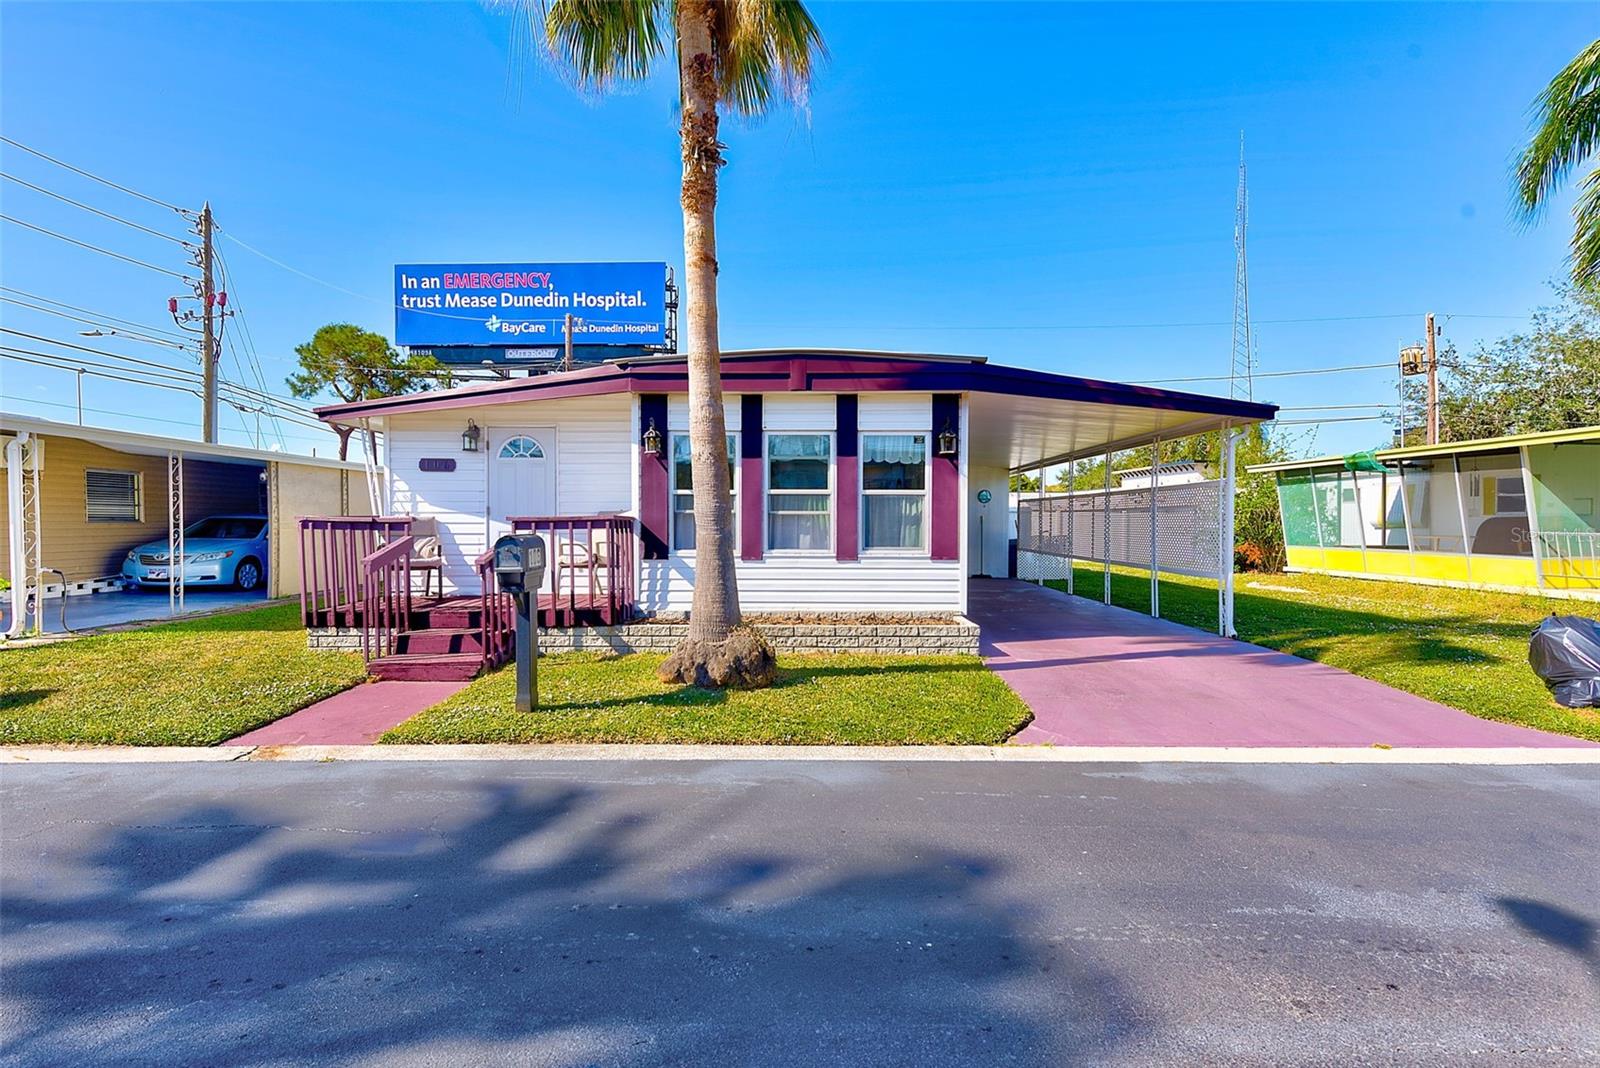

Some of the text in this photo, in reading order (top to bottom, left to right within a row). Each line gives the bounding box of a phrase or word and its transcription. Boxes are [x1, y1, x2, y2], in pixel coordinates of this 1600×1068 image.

[401, 272, 554, 291] In an EMERGENCY,
[401, 290, 647, 312] trust Mease Dunedin Hospital.
[501, 322, 546, 336] BayCare
[561, 323, 659, 334] Mase Dunedin Hospital
